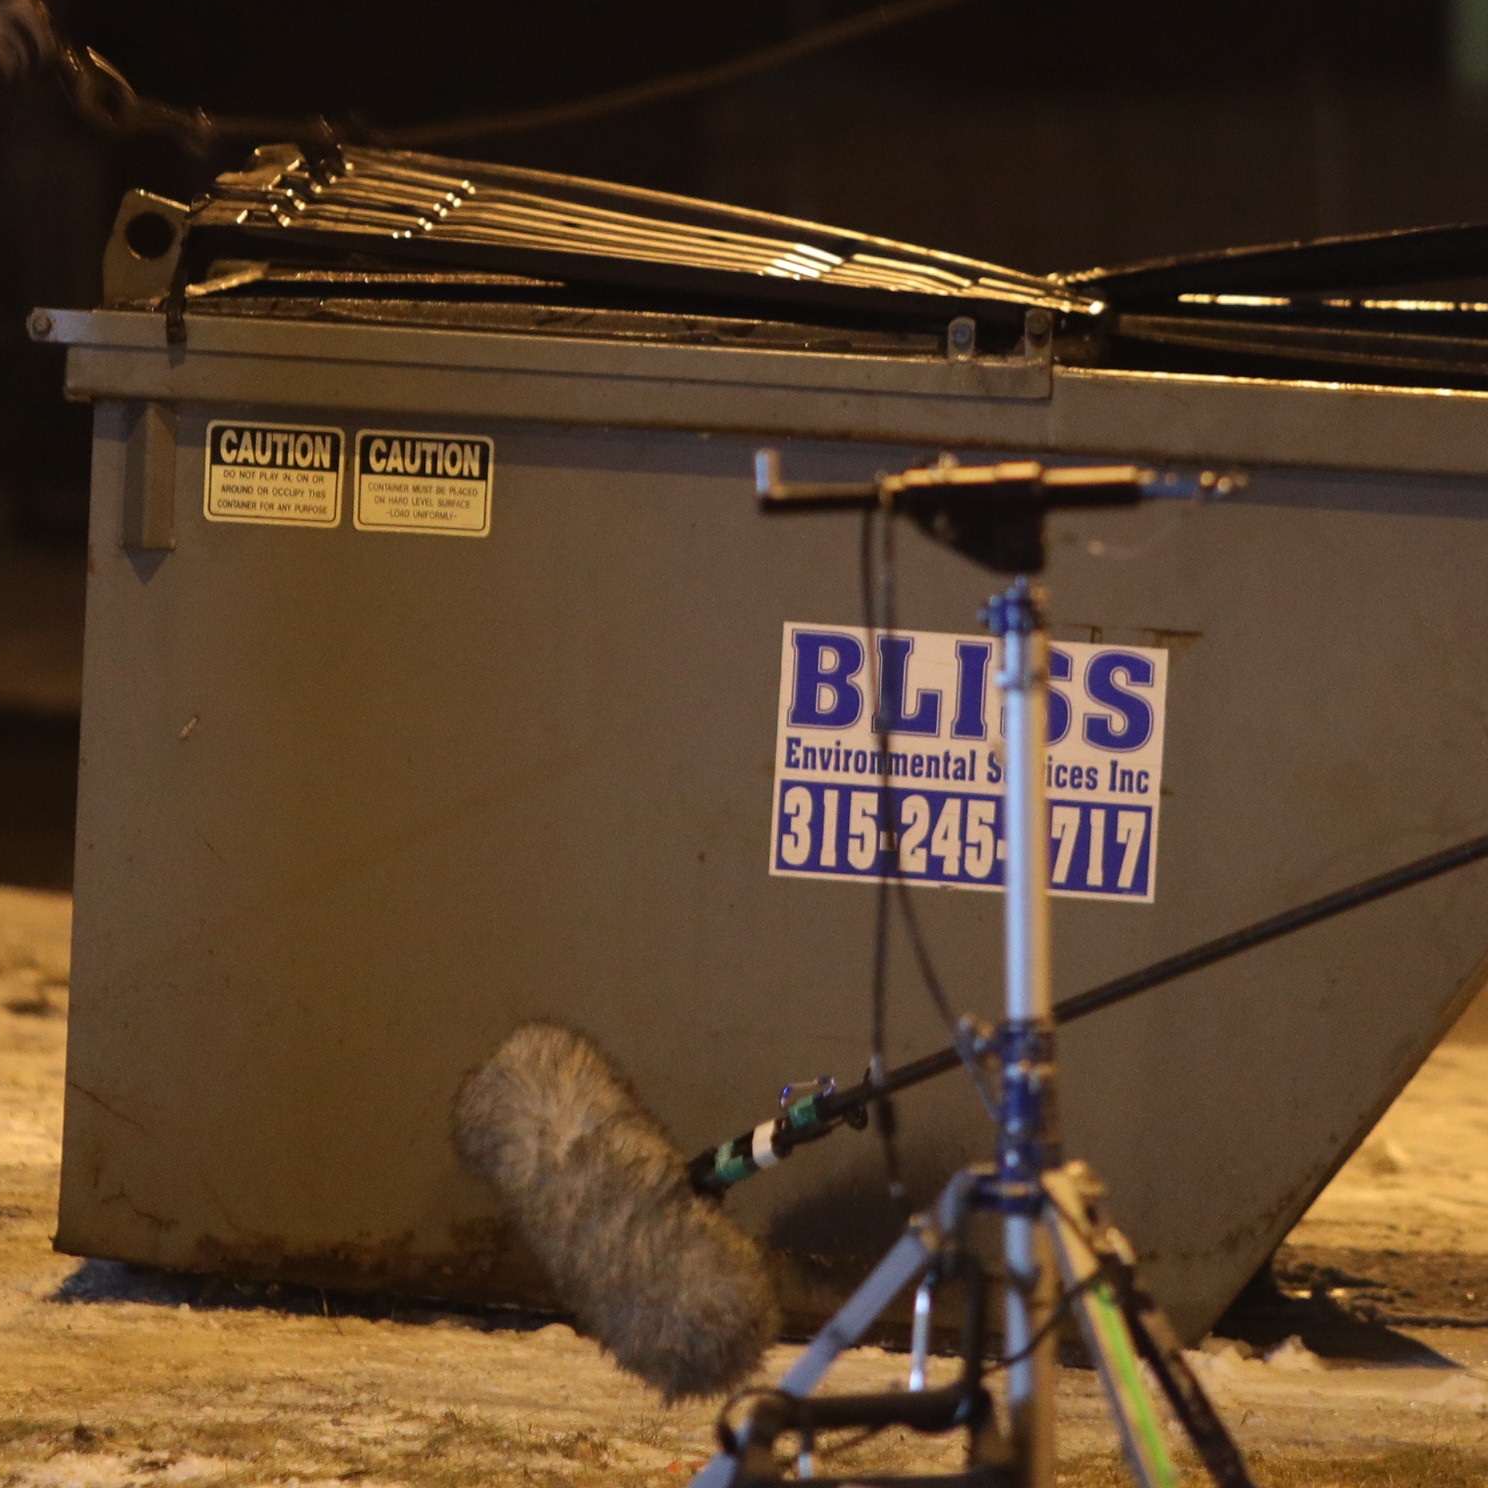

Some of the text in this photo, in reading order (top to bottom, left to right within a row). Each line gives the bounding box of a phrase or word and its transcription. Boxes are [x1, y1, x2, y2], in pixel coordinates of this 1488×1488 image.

[219, 429, 332, 469] CAUTION
[368, 438, 481, 478] CAUTION
[223, 469, 236, 478] DO
[239, 470, 255, 480] NOT
[259, 471, 279, 481] PLAY
[296, 473, 309, 483] ON
[312, 474, 325, 484] OR
[221, 484, 326, 499] AROUND OR OCCUPY THIS
[367, 482, 479, 497] CONTAINER MUST BE PLACED
[217, 499, 327, 514] CONTAINER FOR ANY PURPOSE
[374, 495, 471, 508] ON HARD LEVEL SURFACE
[784, 737, 1150, 795] Environmental Sices Inc
[780, 785, 1147, 889] 315-245-717
